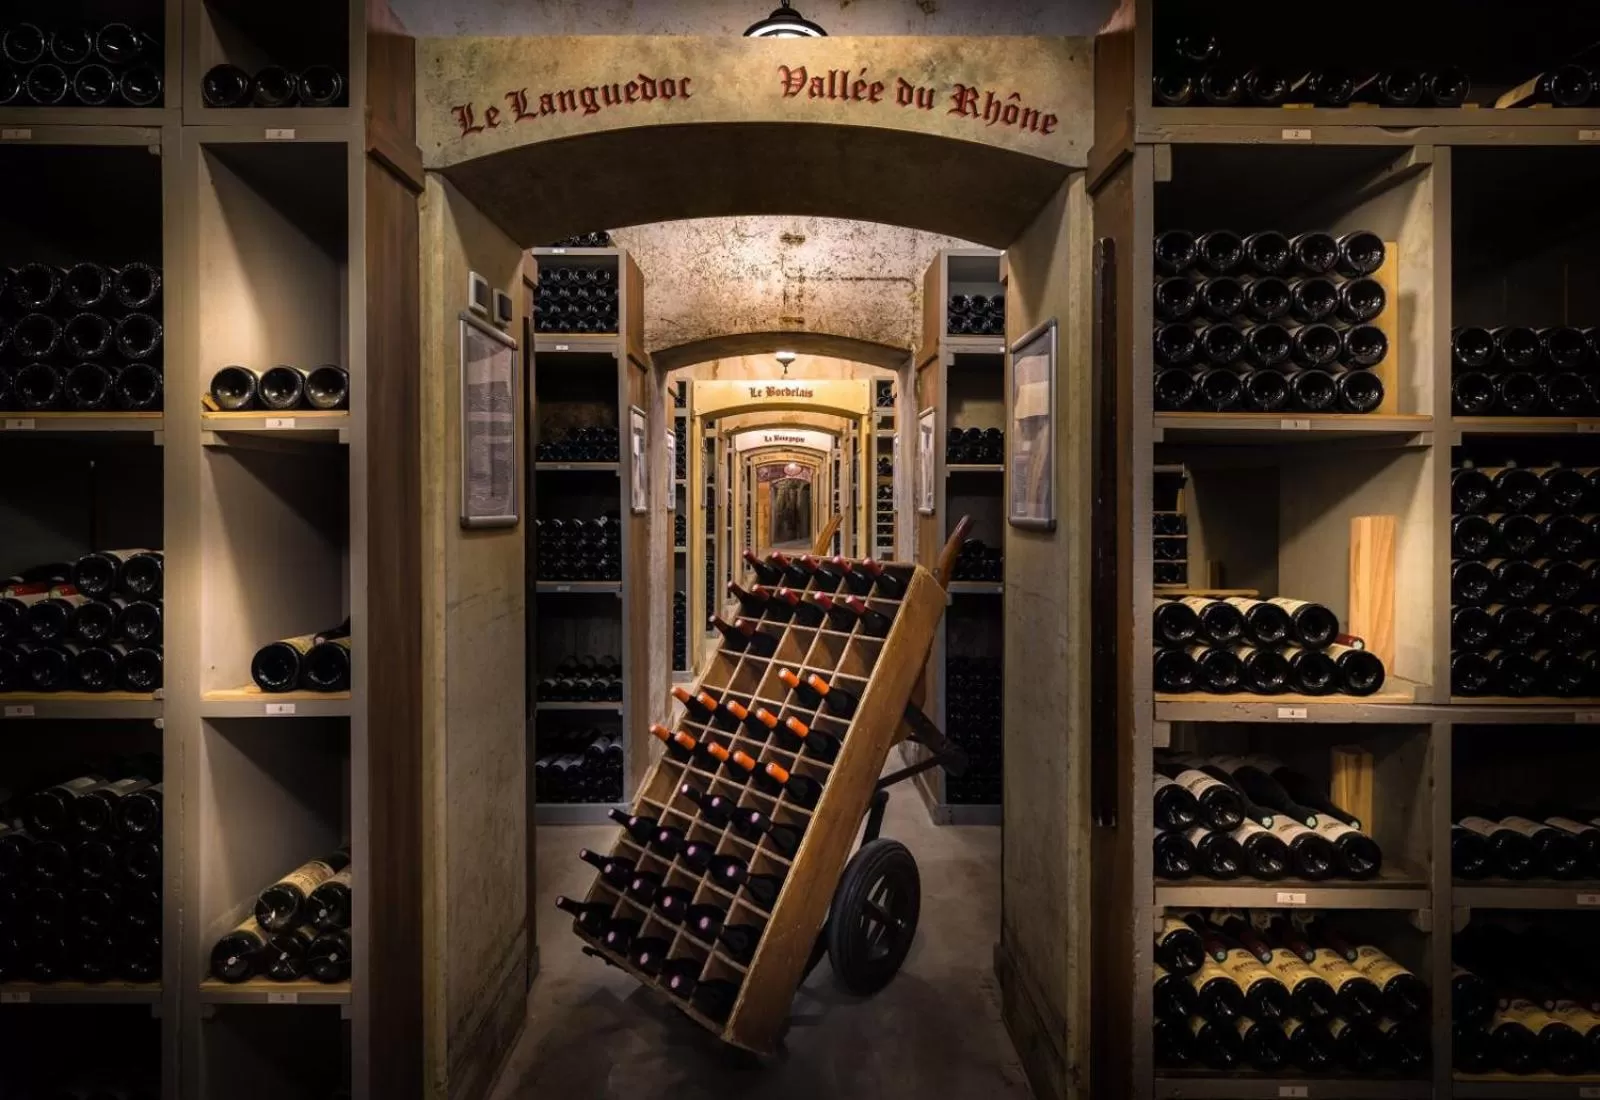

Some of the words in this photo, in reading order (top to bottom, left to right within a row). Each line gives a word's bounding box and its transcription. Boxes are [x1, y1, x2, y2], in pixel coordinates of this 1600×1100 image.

[451, 102, 501, 138] Le
[504, 73, 694, 123] Languedoc
[778, 64, 885, 103] Vallée
[895, 76, 935, 110] du
[946, 83, 1058, 135] Rhône
[748, 386, 762, 398] Le
[765, 385, 814, 398] Bordelais
